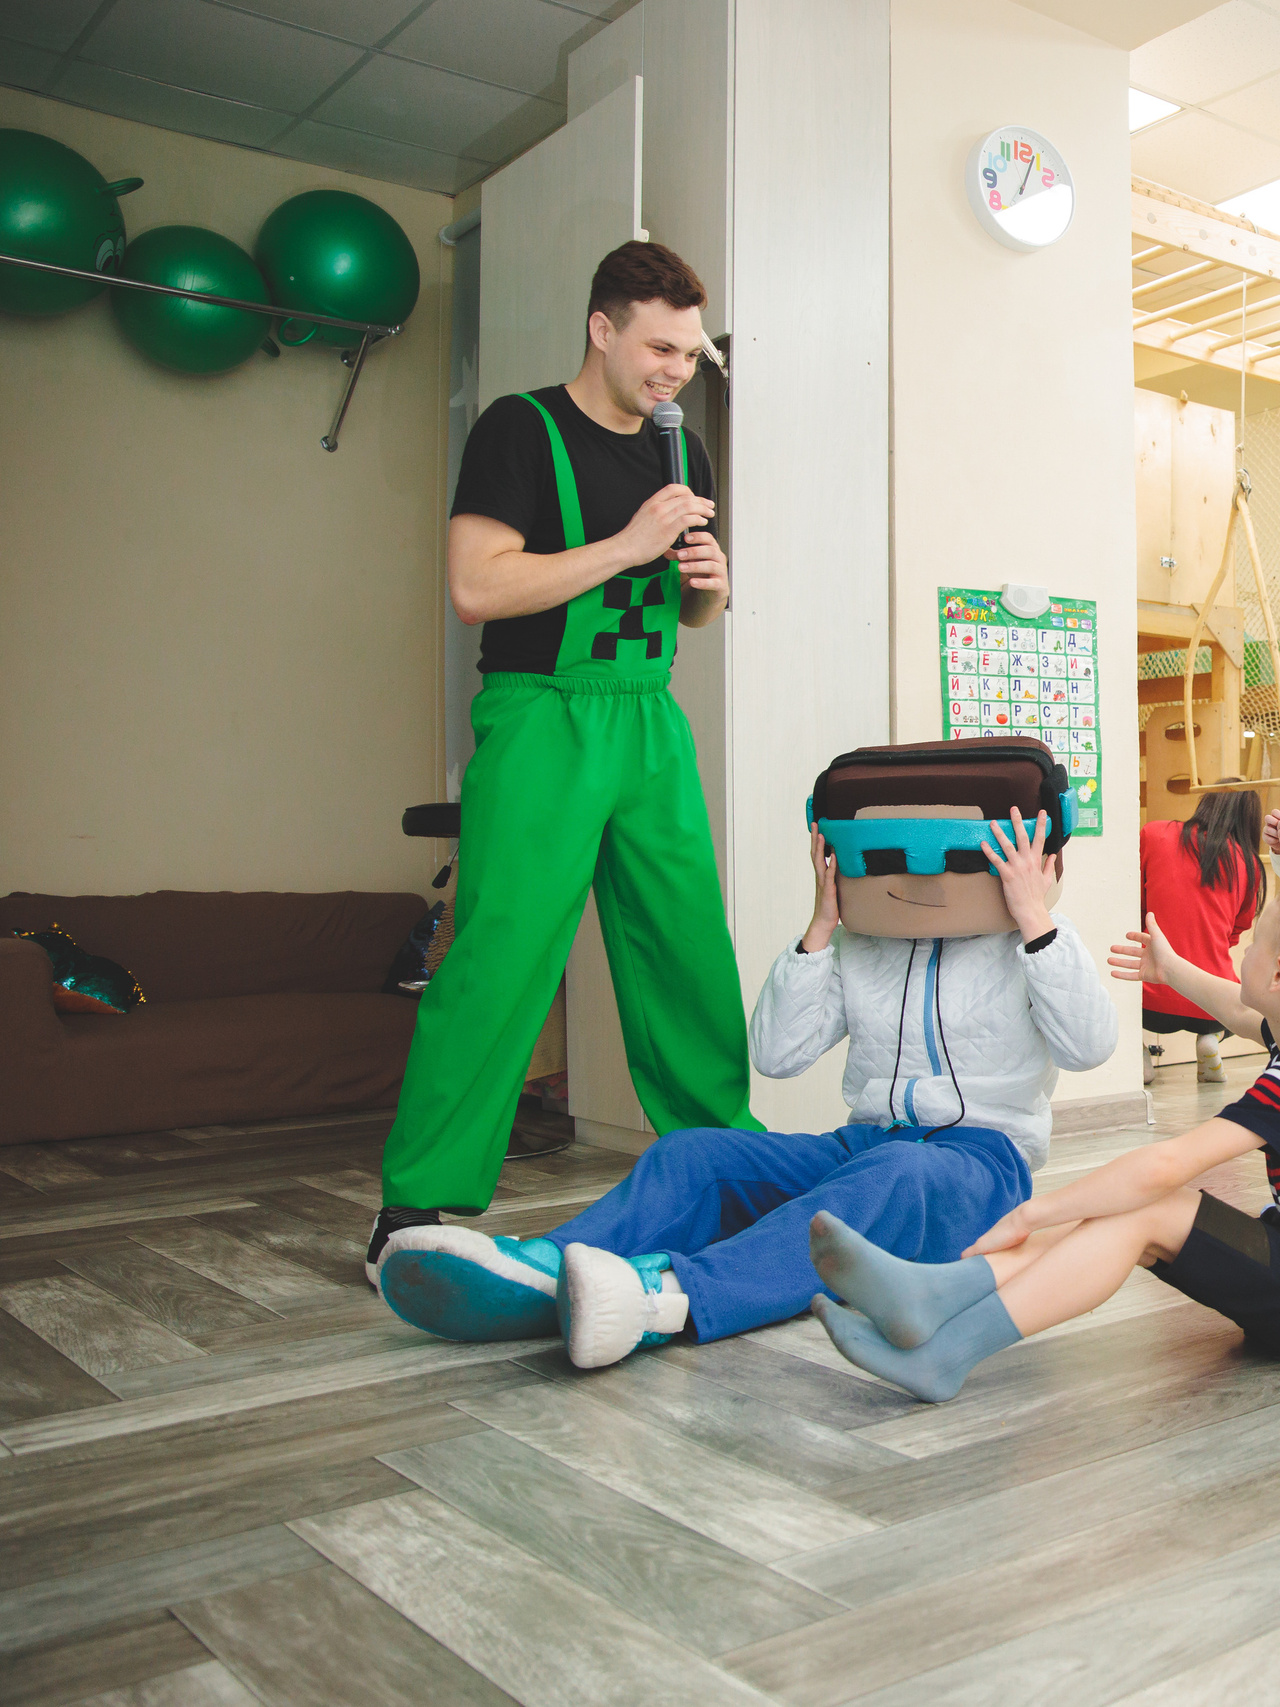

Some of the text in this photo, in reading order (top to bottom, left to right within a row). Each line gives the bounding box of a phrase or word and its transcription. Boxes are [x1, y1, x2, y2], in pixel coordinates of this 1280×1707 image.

[1000, 141, 1010, 162] 11
[1014, 140, 1033, 164] 12
[988, 152, 1008, 173] 10
[1036, 153, 1040, 171] 1
[983, 168, 998, 188] 9
[1042, 167, 1054, 188] 2
[989, 190, 1002, 210] 8
[946, 607, 996, 622] АЗБУКА
[950, 625, 957, 638] А
[980, 627, 988, 640] Б
[1011, 629, 1019, 641] В
[1041, 631, 1047, 643] Г
[1068, 634, 1076, 647] Д
[951, 651, 958, 663] Е
[983, 651, 990, 666] Ё
[1012, 654, 1023, 666] Ж
[1042, 656, 1049, 668] З
[1070, 658, 1078, 669] И
[951, 676, 960, 690] Й
[983, 678, 991, 690] К
[1012, 679, 1021, 691] Л
[1042, 681, 1051, 693] М
[1071, 682, 1079, 694] Н
[952, 702, 961, 715] О
[983, 704, 991, 716] П
[1015, 705, 1022, 716] Р
[1043, 706, 1051, 718] С
[1073, 707, 1079, 718] Т
[954, 728, 962, 740] У
[984, 729, 994, 737] Ф
[1045, 731, 1053, 745] Ц
[1073, 732, 1079, 743] Ч
